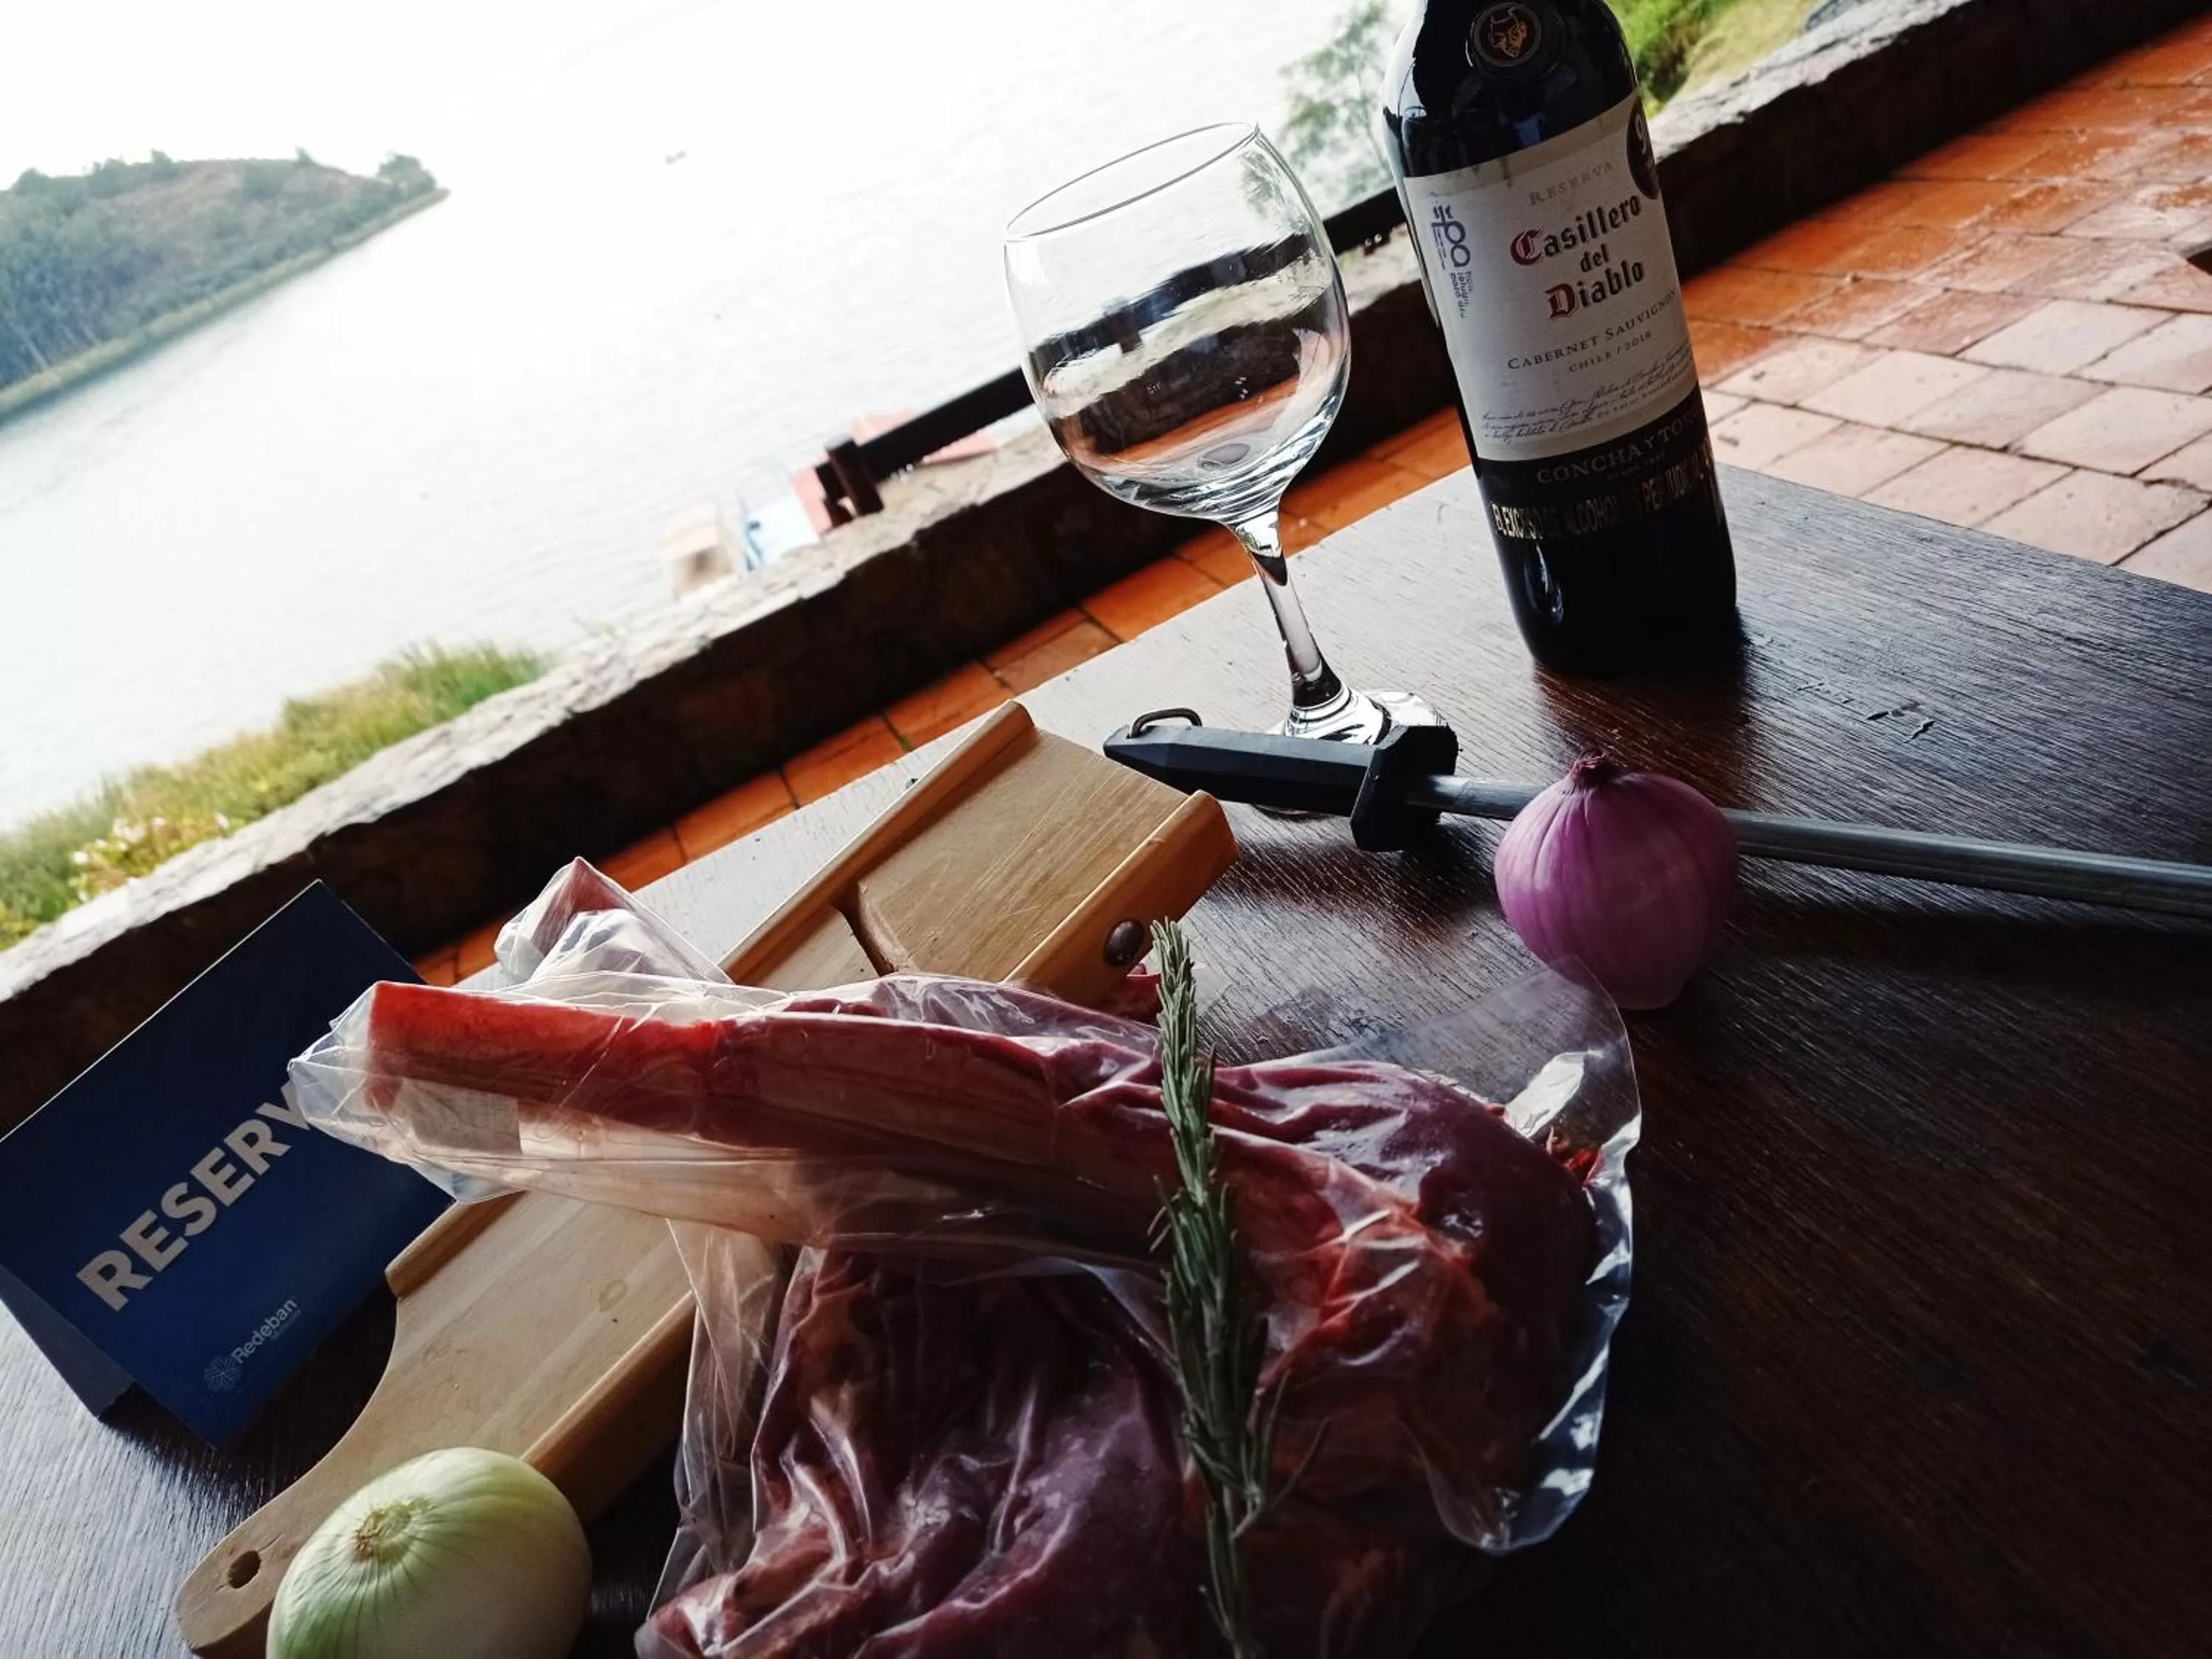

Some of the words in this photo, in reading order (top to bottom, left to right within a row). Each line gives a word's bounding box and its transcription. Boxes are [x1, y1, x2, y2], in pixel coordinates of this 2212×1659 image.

[1529, 161, 1614, 206] RESERVA
[1510, 195, 1642, 266] Casillero
[1579, 244, 1610, 273] del
[1544, 260, 1644, 319] Diablo
[1507, 335, 1599, 369] CABERNET
[1536, 443, 1644, 484] CONCHA
[1657, 409, 1700, 444] TOR
[230, 1298, 299, 1364] Redeban
